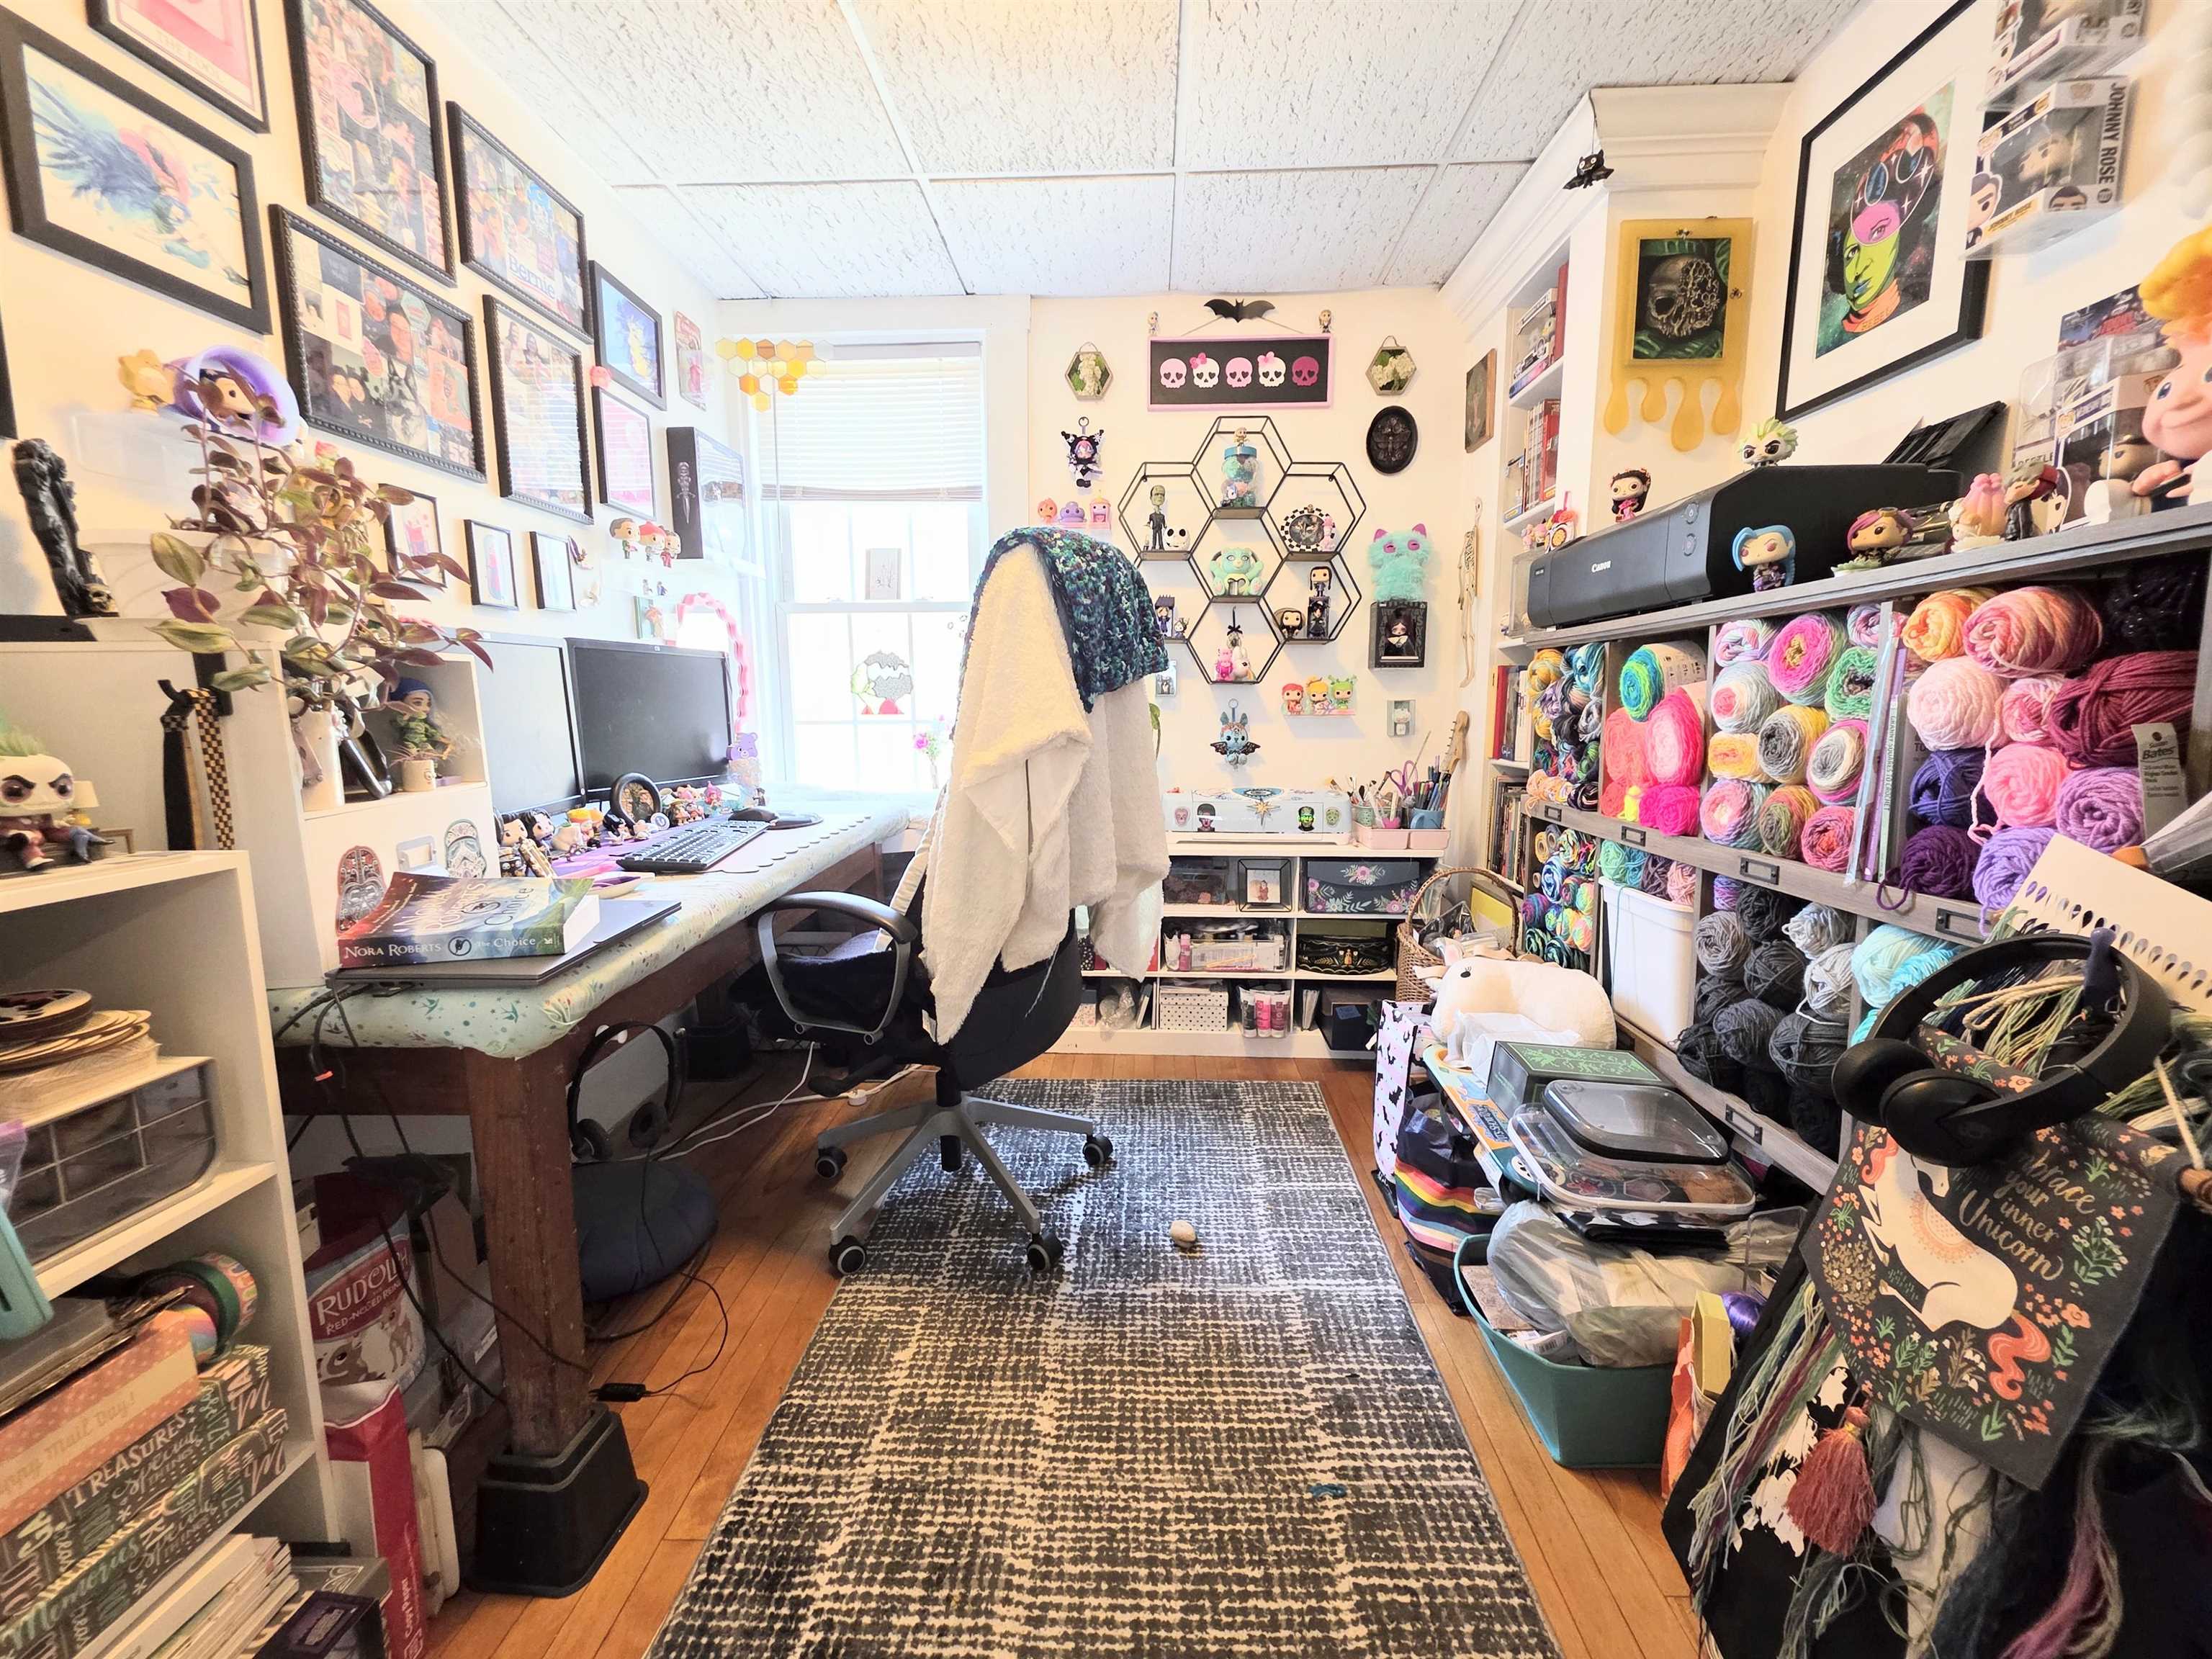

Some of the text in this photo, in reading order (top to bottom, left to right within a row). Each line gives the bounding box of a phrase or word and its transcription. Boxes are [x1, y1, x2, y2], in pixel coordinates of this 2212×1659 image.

[2098, 82, 2127, 185] JOHNNY ROSE
[508, 257, 555, 300] Bernie
[1591, 560, 1611, 574] Canon
[2143, 747, 2173, 760] Bates
[344, 945, 385, 959] NORA
[389, 942, 441, 957] ROBERTS
[494, 937, 536, 948] Choice
[1993, 1170, 2050, 1208] your
[1959, 1189, 2064, 1281] Unicorn
[2000, 1197, 2059, 1243] inner
[316, 1247, 408, 1326] RUDOLH
[66, 1412, 187, 1509] TREASURES
